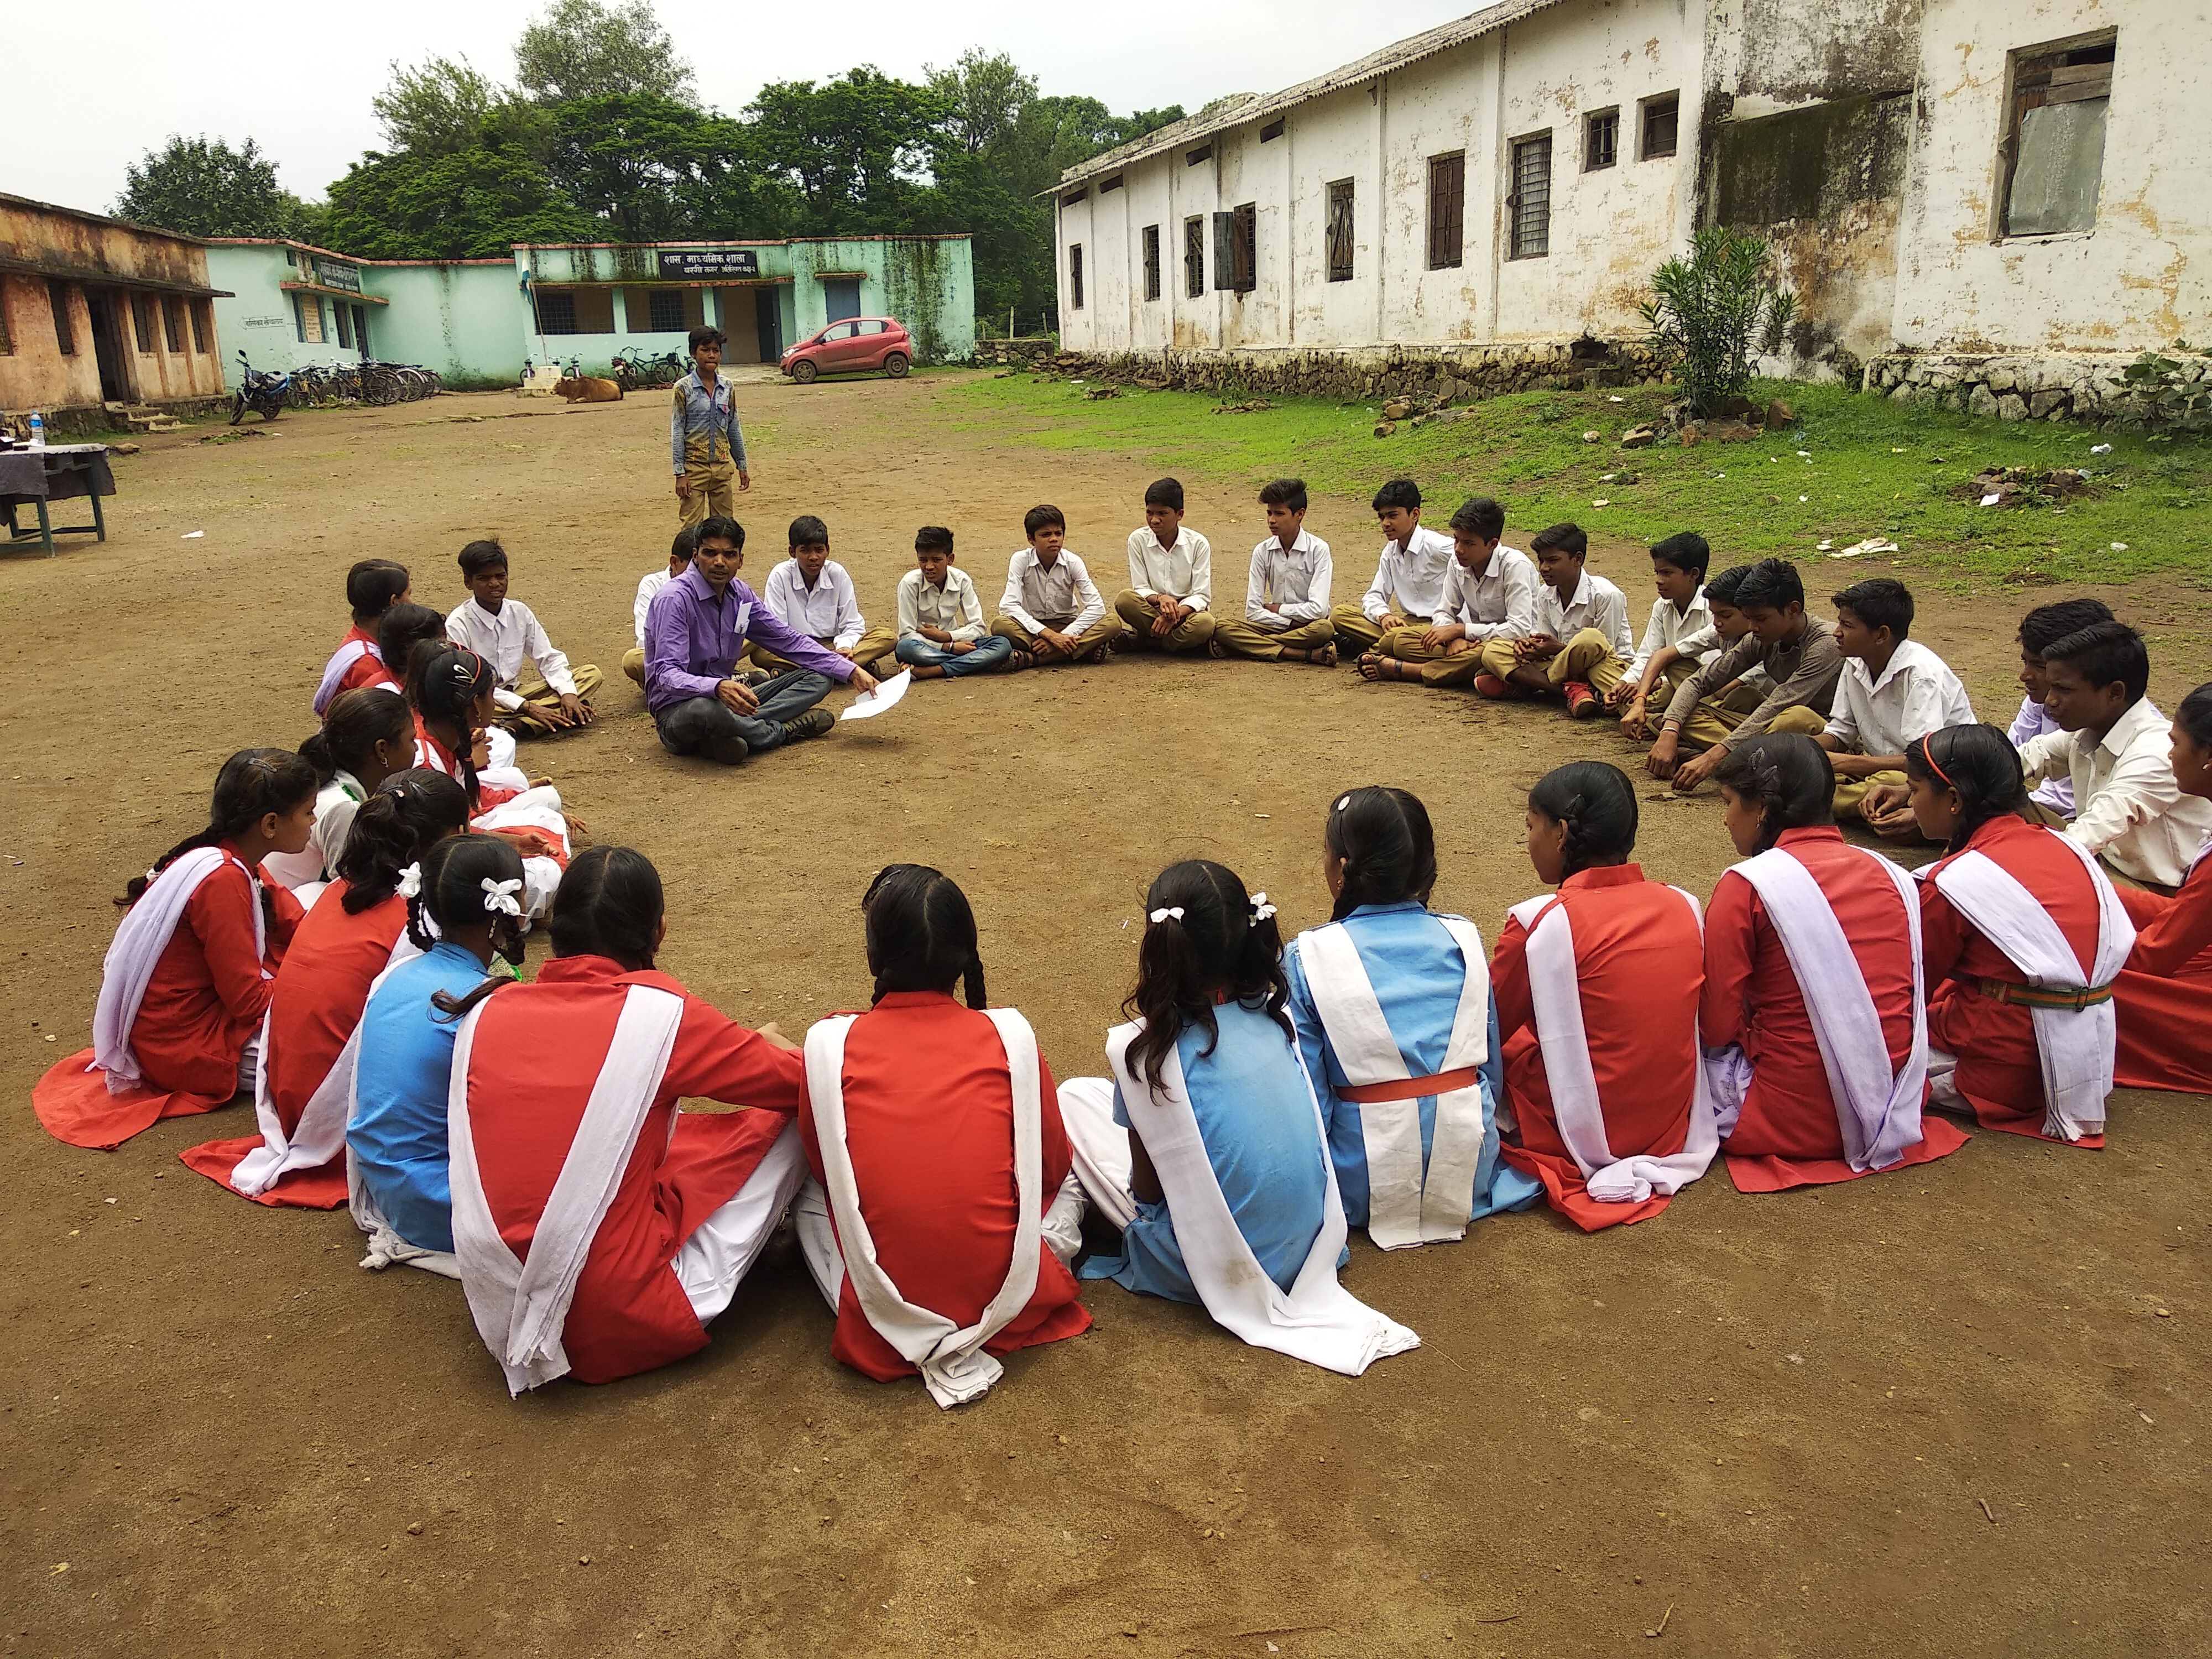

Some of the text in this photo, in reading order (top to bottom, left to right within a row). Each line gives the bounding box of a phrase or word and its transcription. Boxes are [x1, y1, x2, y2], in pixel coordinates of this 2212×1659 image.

[664, 253, 745, 266] शास. माध्यमिक शाला
